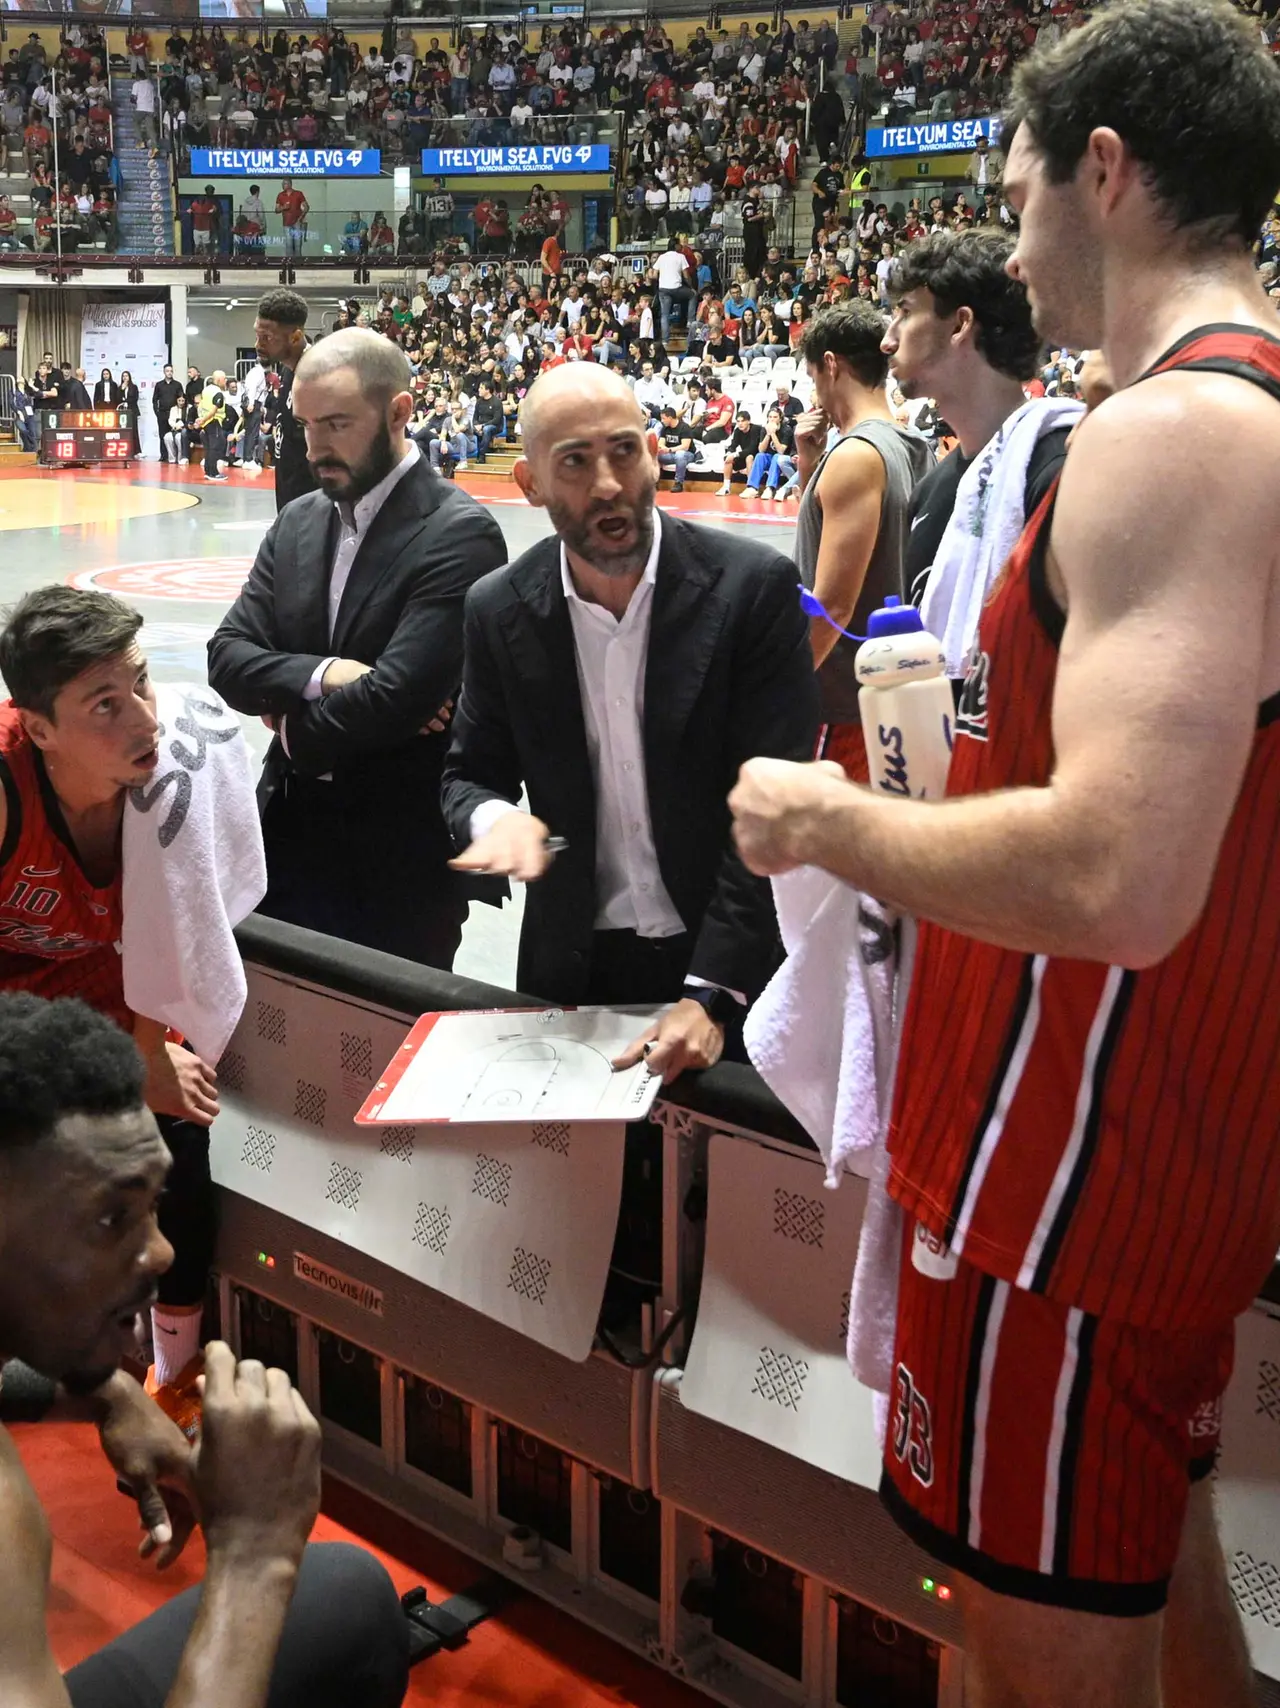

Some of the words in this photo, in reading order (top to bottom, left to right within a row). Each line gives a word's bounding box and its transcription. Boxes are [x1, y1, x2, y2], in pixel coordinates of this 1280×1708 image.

[882, 123, 947, 148] ITELYUM
[952, 120, 983, 141] SEA
[919, 141, 966, 152] ENVIRONMENTAL
[208, 150, 273, 168] ITELYUM
[279, 150, 309, 168] SEA
[314, 150, 343, 168] FVG
[439, 149, 503, 167] ITELYUM
[508, 147, 538, 165] SEA
[543, 146, 572, 164] FVG
[476, 165, 522, 173] ENVIRONMENTAL
[522, 164, 553, 172] SOLUTIONS
[634, 260, 640, 272] J
[112, 320, 120, 328] ALL
[57, 442, 73, 457] 18
[106, 442, 128, 457] 22
[1, 881, 61, 915] 10
[893, 1362, 934, 1488] 33
